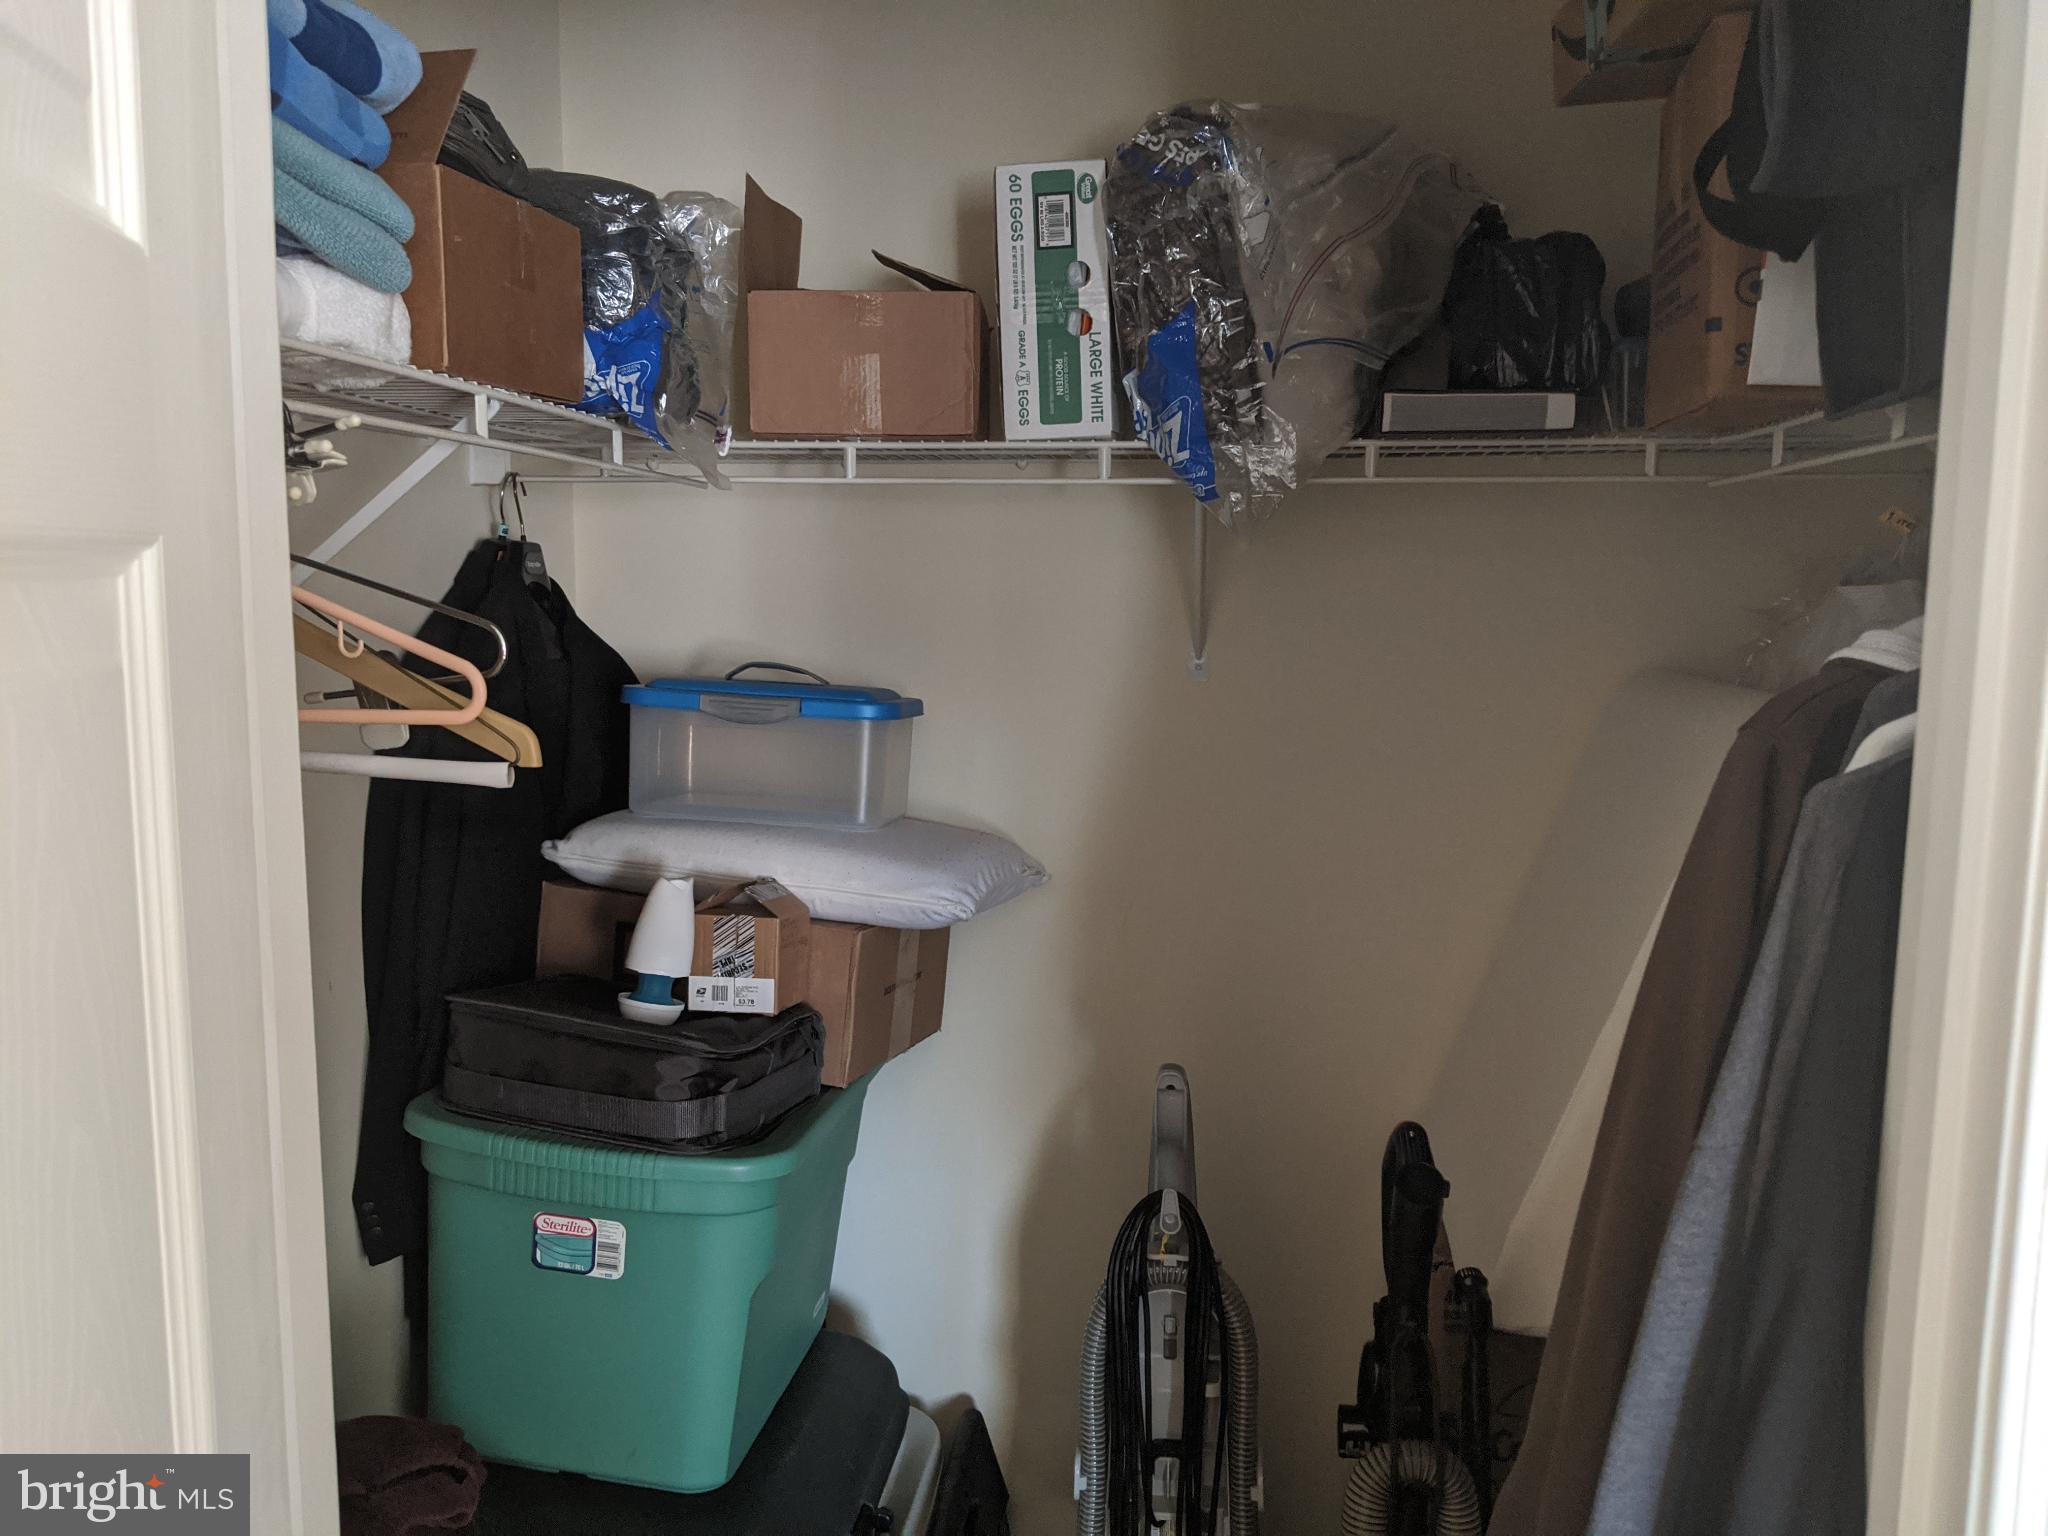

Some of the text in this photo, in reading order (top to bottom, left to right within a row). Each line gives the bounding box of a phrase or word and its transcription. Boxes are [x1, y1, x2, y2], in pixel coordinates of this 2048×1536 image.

[1009, 174, 1022, 193] 60
[1084, 176, 1093, 199] Great
[1010, 198, 1024, 243] EGGS
[1018, 330, 1026, 359] GRADE
[1056, 358, 1064, 396] PROTEIN
[1089, 332, 1104, 423] LARGE WHITE
[1018, 390, 1029, 426] EGGS
[719, 955, 736, 969] TAPE
[541, 1217, 589, 1234] Sterilite
